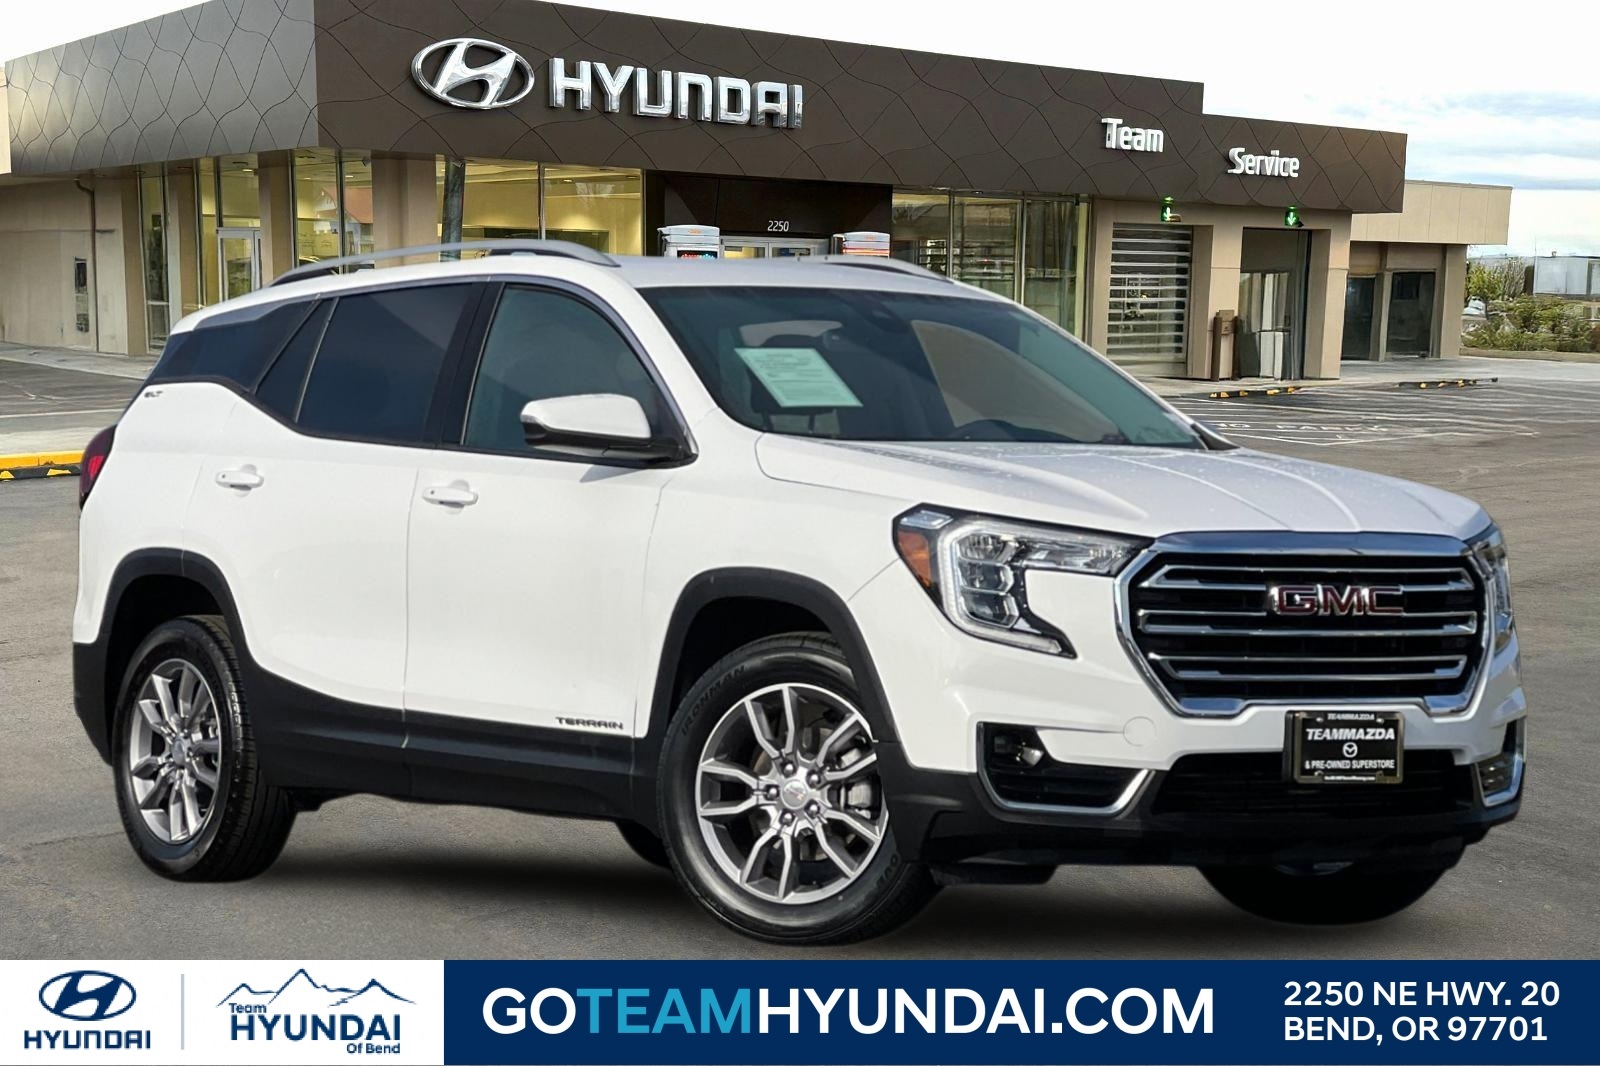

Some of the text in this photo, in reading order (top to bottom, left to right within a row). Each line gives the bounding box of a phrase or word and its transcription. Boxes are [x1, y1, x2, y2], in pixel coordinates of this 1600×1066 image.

[549, 57, 804, 129] HYUNDAI
[1101, 117, 1164, 152] Team
[1227, 147, 1300, 178] Service
[767, 220, 790, 232] 2250
[1269, 584, 1404, 616] GMC
[555, 716, 624, 730] TERRAIN
[1311, 760, 1351, 770] PRE-OWNED
[1352, 759, 1396, 770] SUPERSTORE
